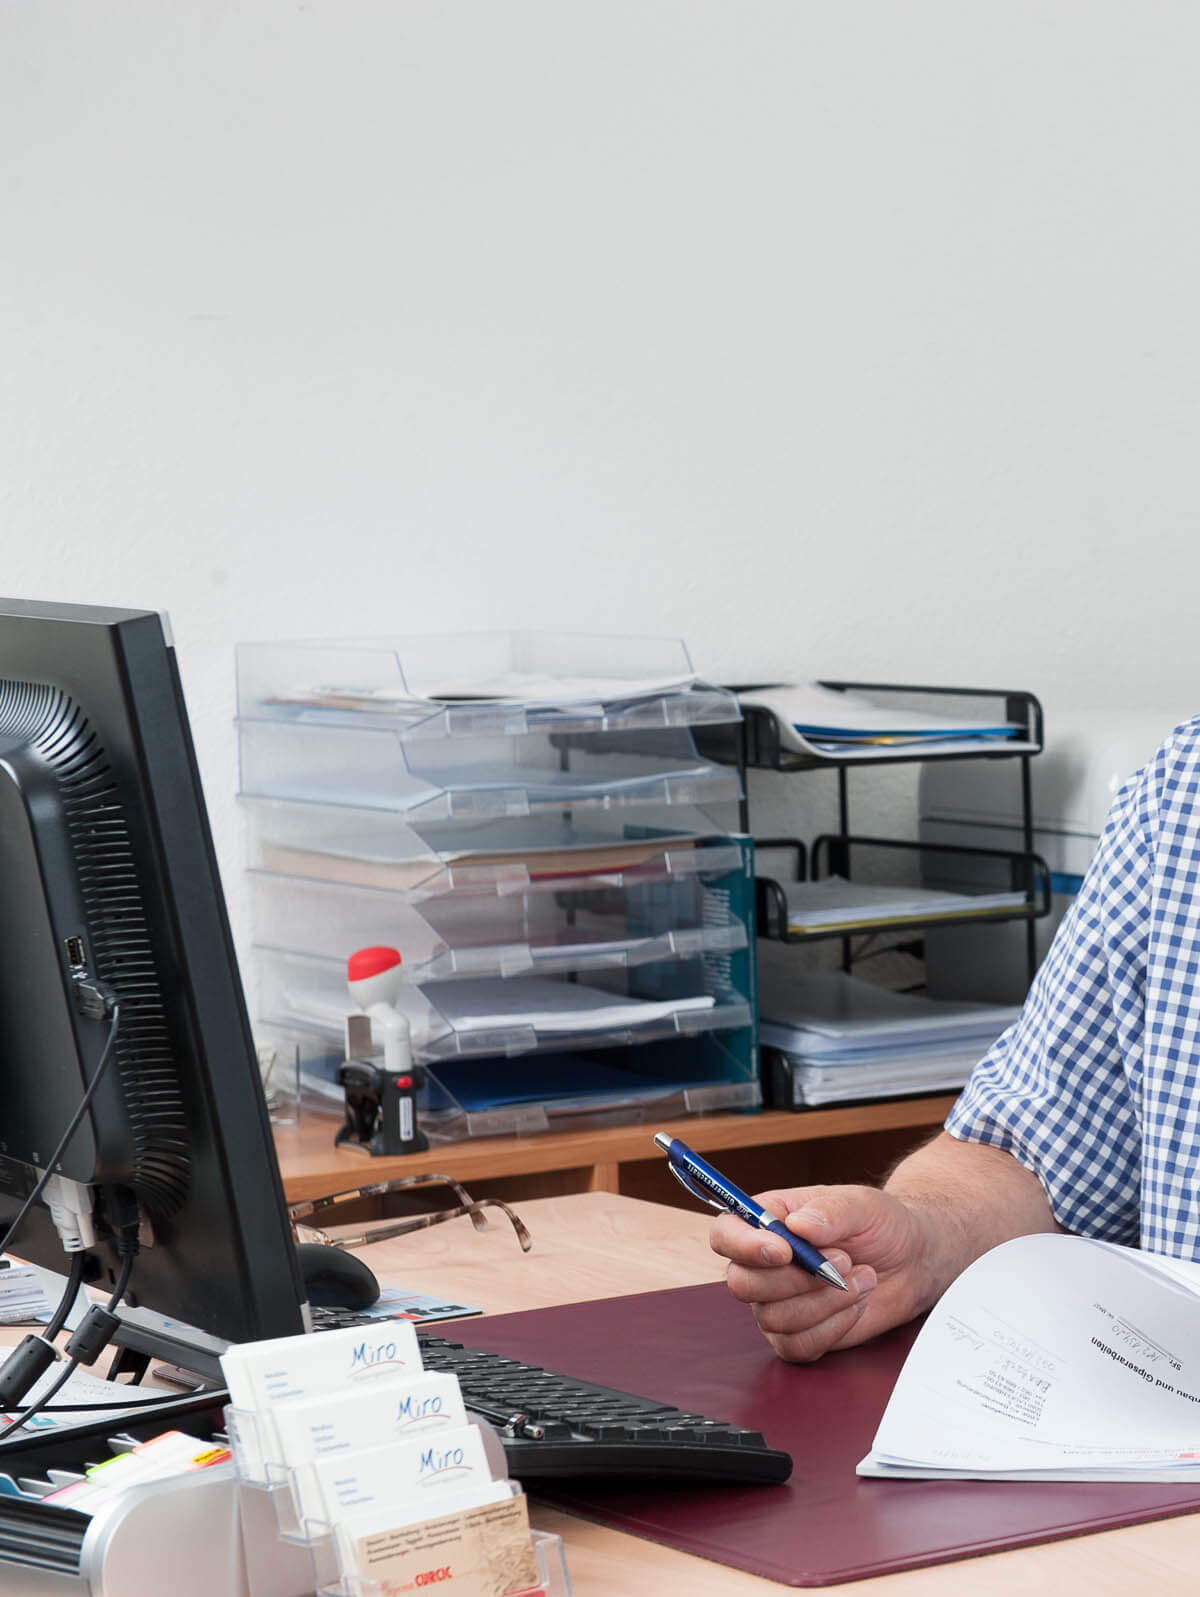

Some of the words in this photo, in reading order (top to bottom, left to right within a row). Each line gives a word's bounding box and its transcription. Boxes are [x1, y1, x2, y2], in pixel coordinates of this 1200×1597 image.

[352, 1342, 397, 1367] Miro
[1091, 1336, 1154, 1383] Gipserarbeiten
[1155, 1379, 1175, 1393] und
[397, 1395, 442, 1421] Miro
[420, 1447, 464, 1473] Miro
